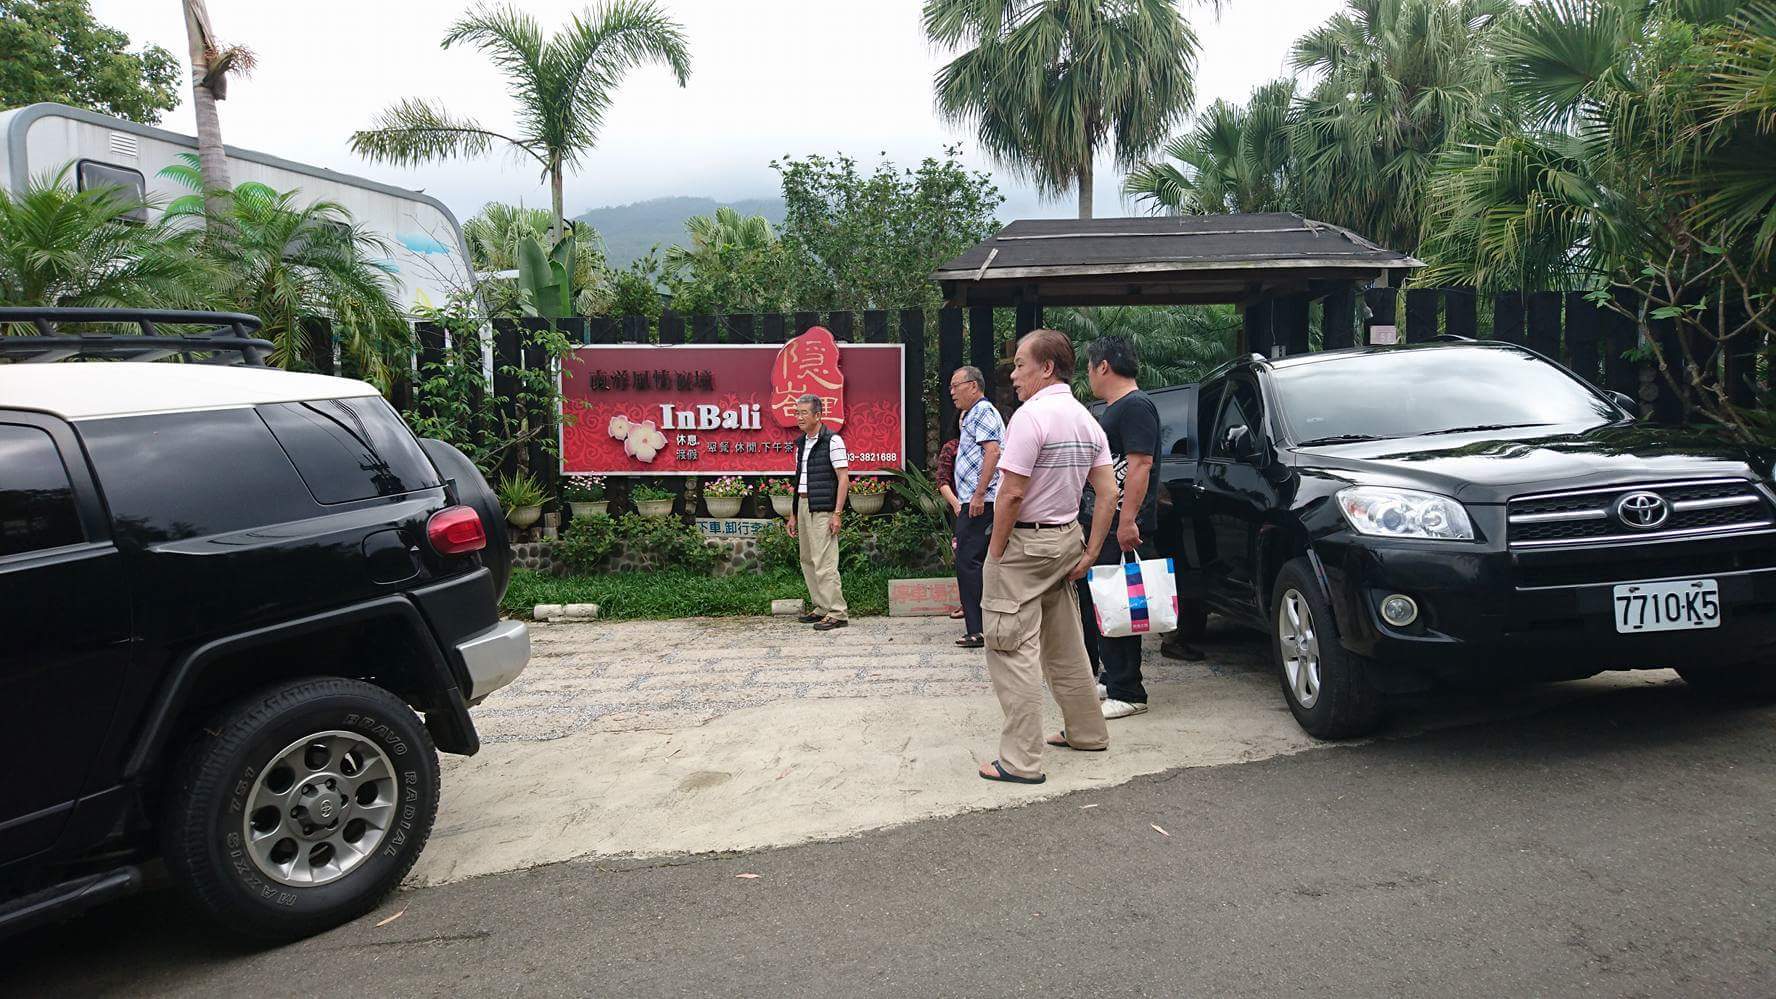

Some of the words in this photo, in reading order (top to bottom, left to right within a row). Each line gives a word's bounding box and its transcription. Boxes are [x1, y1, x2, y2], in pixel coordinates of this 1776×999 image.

[659, 404, 762, 431] InBali
[345, 713, 408, 757] BRAVO
[384, 771, 418, 857] RADIAL
[226, 831, 297, 906] MAXXIS
